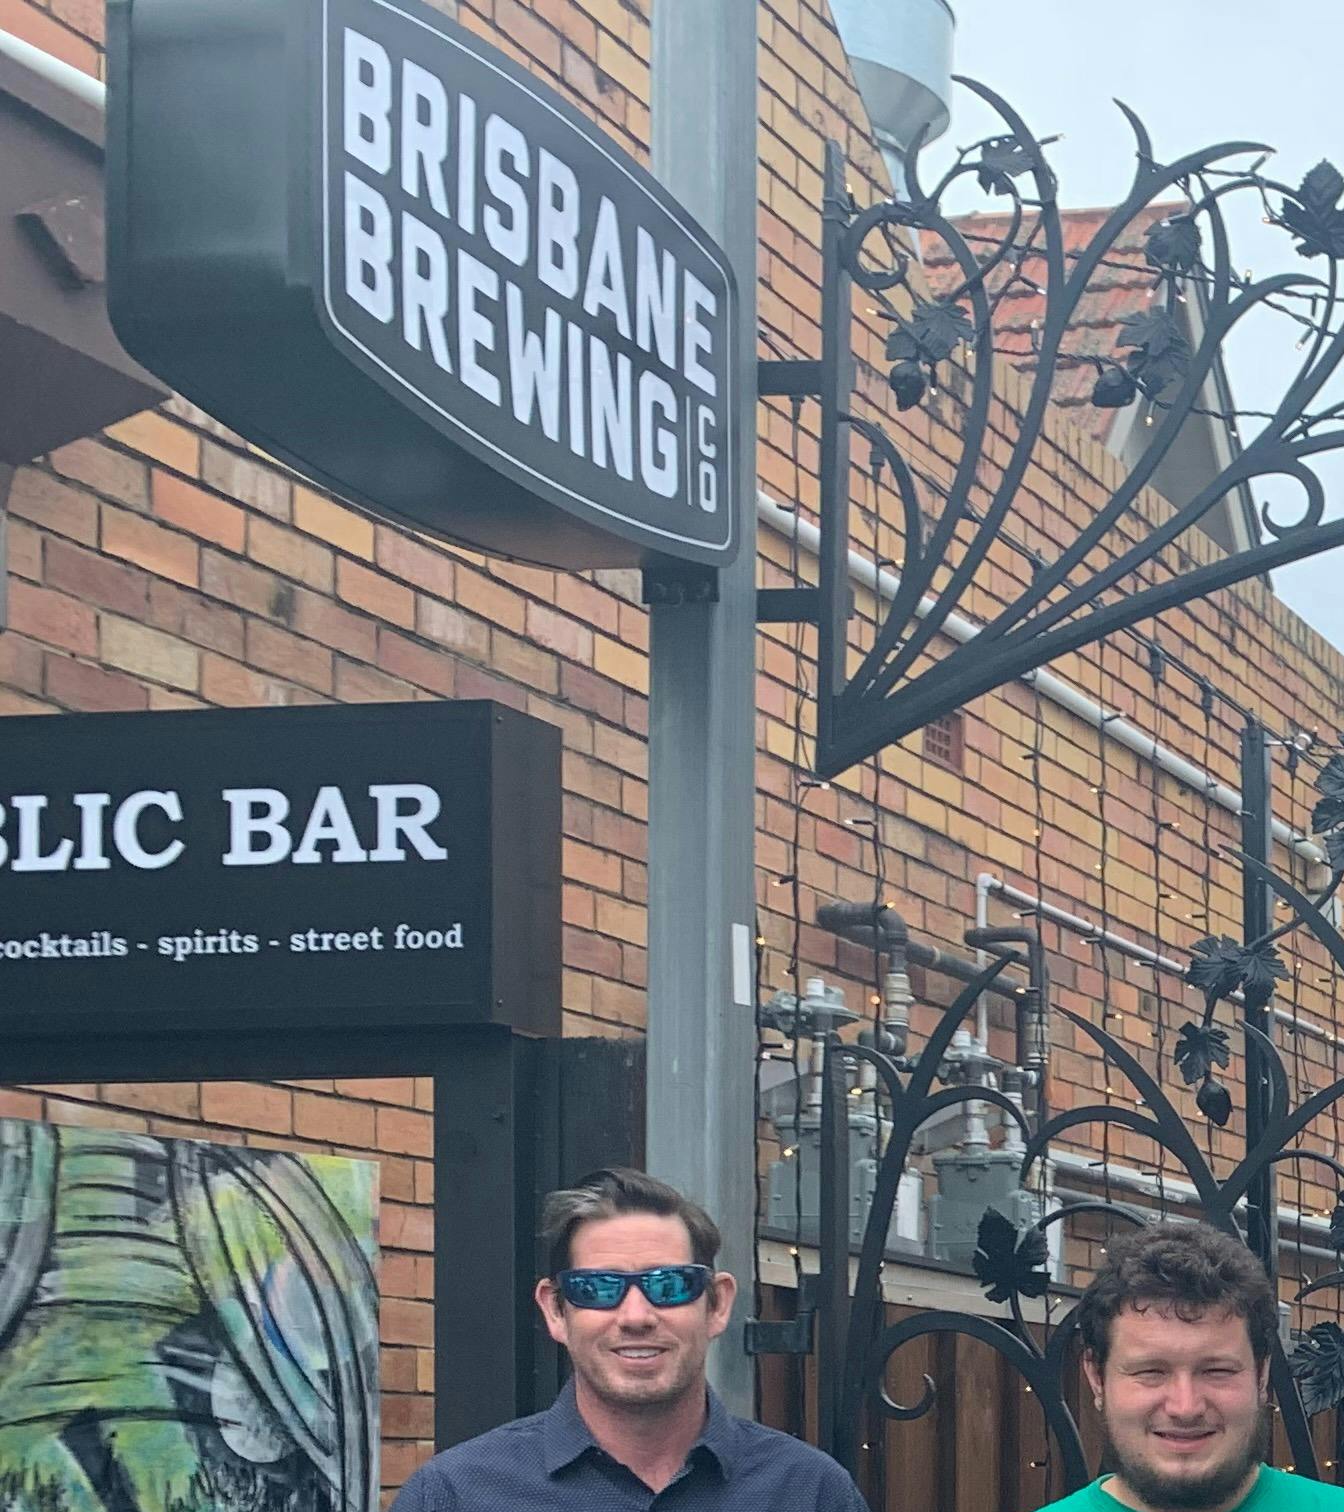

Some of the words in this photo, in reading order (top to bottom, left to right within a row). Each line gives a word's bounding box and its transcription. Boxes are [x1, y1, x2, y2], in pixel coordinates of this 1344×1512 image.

[343, 26, 717, 398] BRISBANE
[343, 169, 679, 499] BREWING
[697, 405, 718, 514] CO
[221, 783, 448, 866] BAR
[0, 930, 129, 959] ocktails
[157, 928, 260, 961] spirits
[289, 924, 384, 953] street
[393, 922, 464, 950] food
